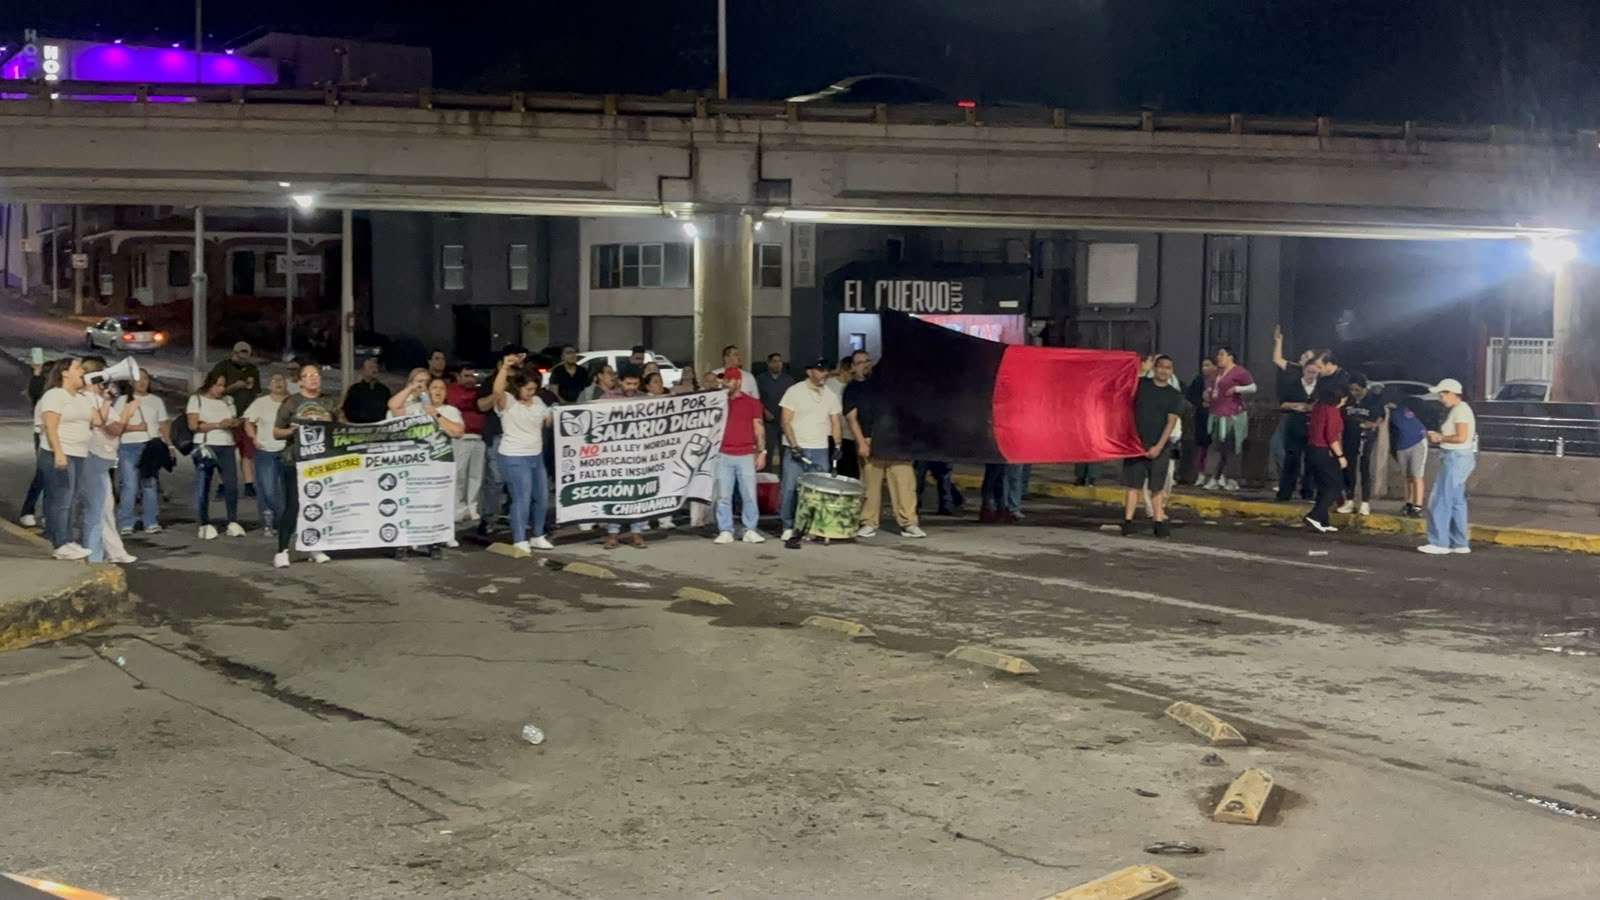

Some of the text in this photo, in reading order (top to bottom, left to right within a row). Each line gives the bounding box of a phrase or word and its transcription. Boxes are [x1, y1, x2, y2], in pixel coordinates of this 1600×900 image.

[844, 280, 950, 312] EL CUERVO
[609, 395, 706, 422] MARCHA POR
[591, 418, 668, 443] SALARIO
[579, 437, 681, 457] NO A LA LEY MORDAZA
[366, 452, 427, 468] DEMANDAS
[650, 453, 659, 463] AL
[580, 463, 665, 480] FALTA DE INSUMOS
[571, 479, 657, 500] SECCIÓN VIII
[611, 497, 678, 515] CHIHUAHUA
